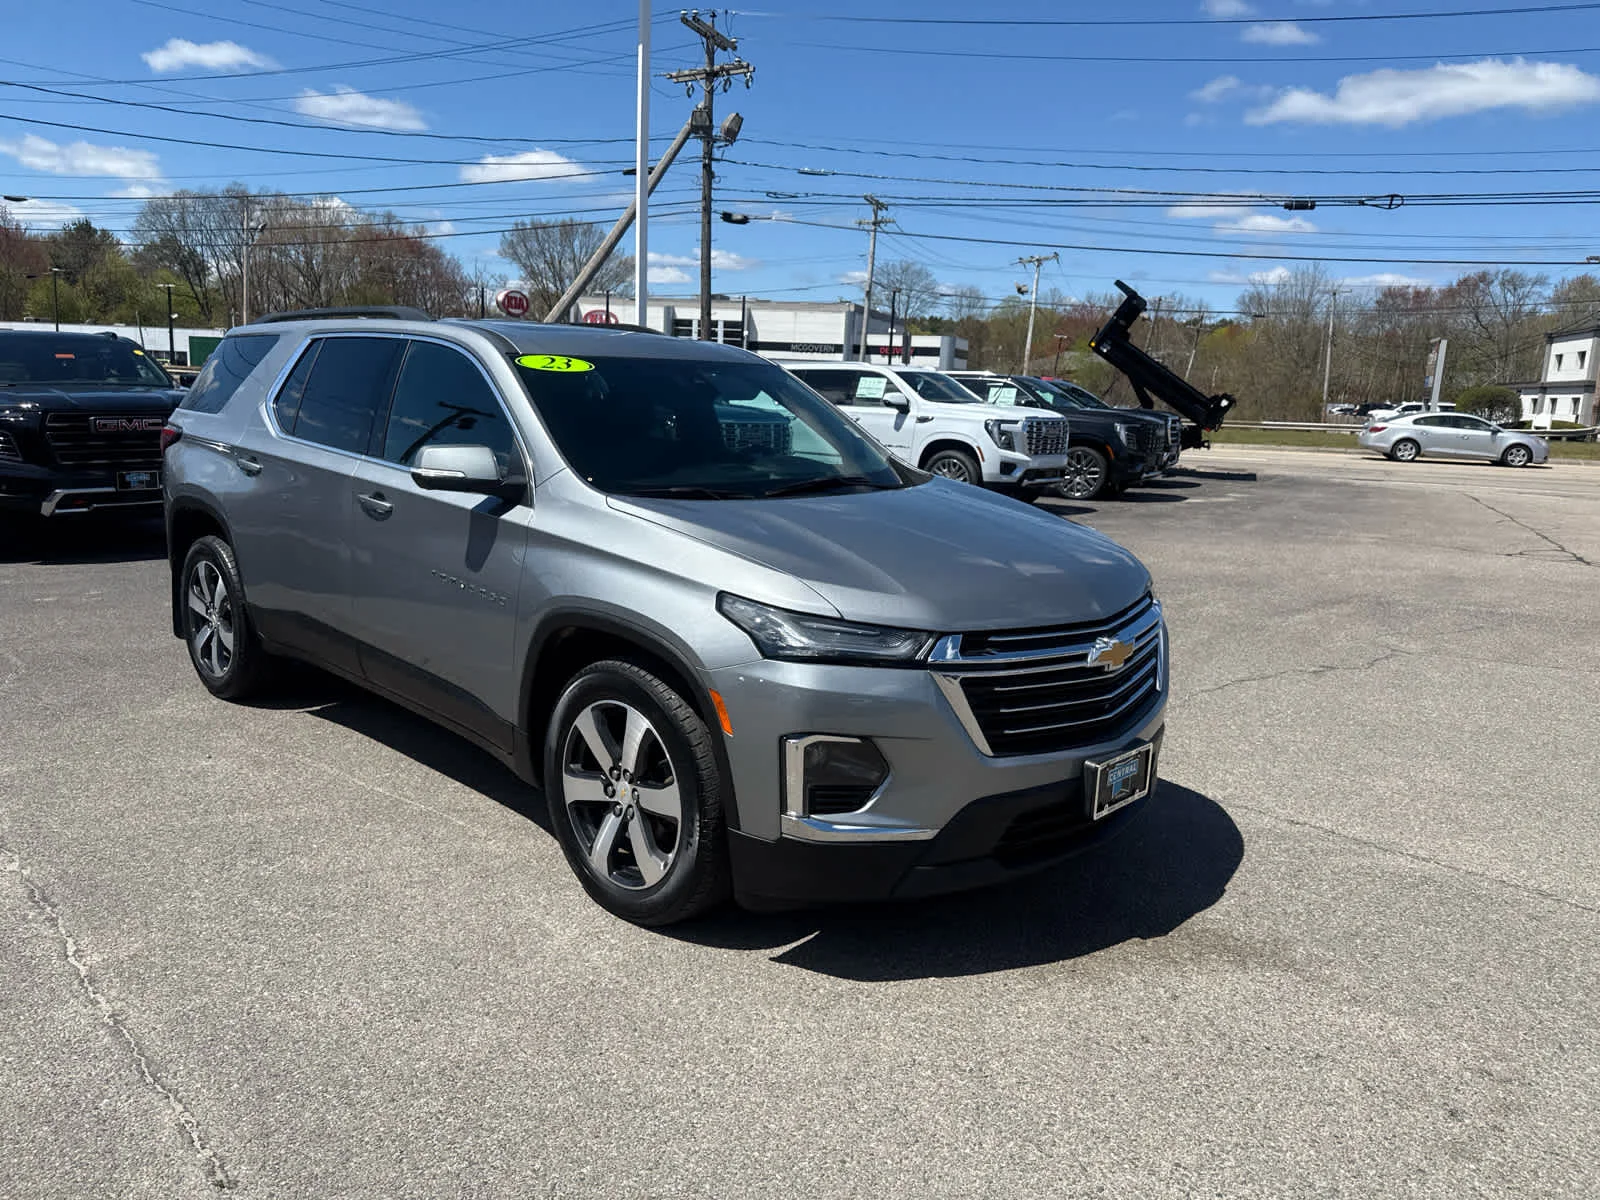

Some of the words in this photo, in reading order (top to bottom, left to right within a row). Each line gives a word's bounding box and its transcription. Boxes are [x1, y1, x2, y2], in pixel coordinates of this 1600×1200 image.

[791, 343, 835, 353] MCGOVERN
[540, 357, 572, 370] 23
[96, 419, 163, 432] GMC
[1109, 762, 1137, 781] CENTRAL
